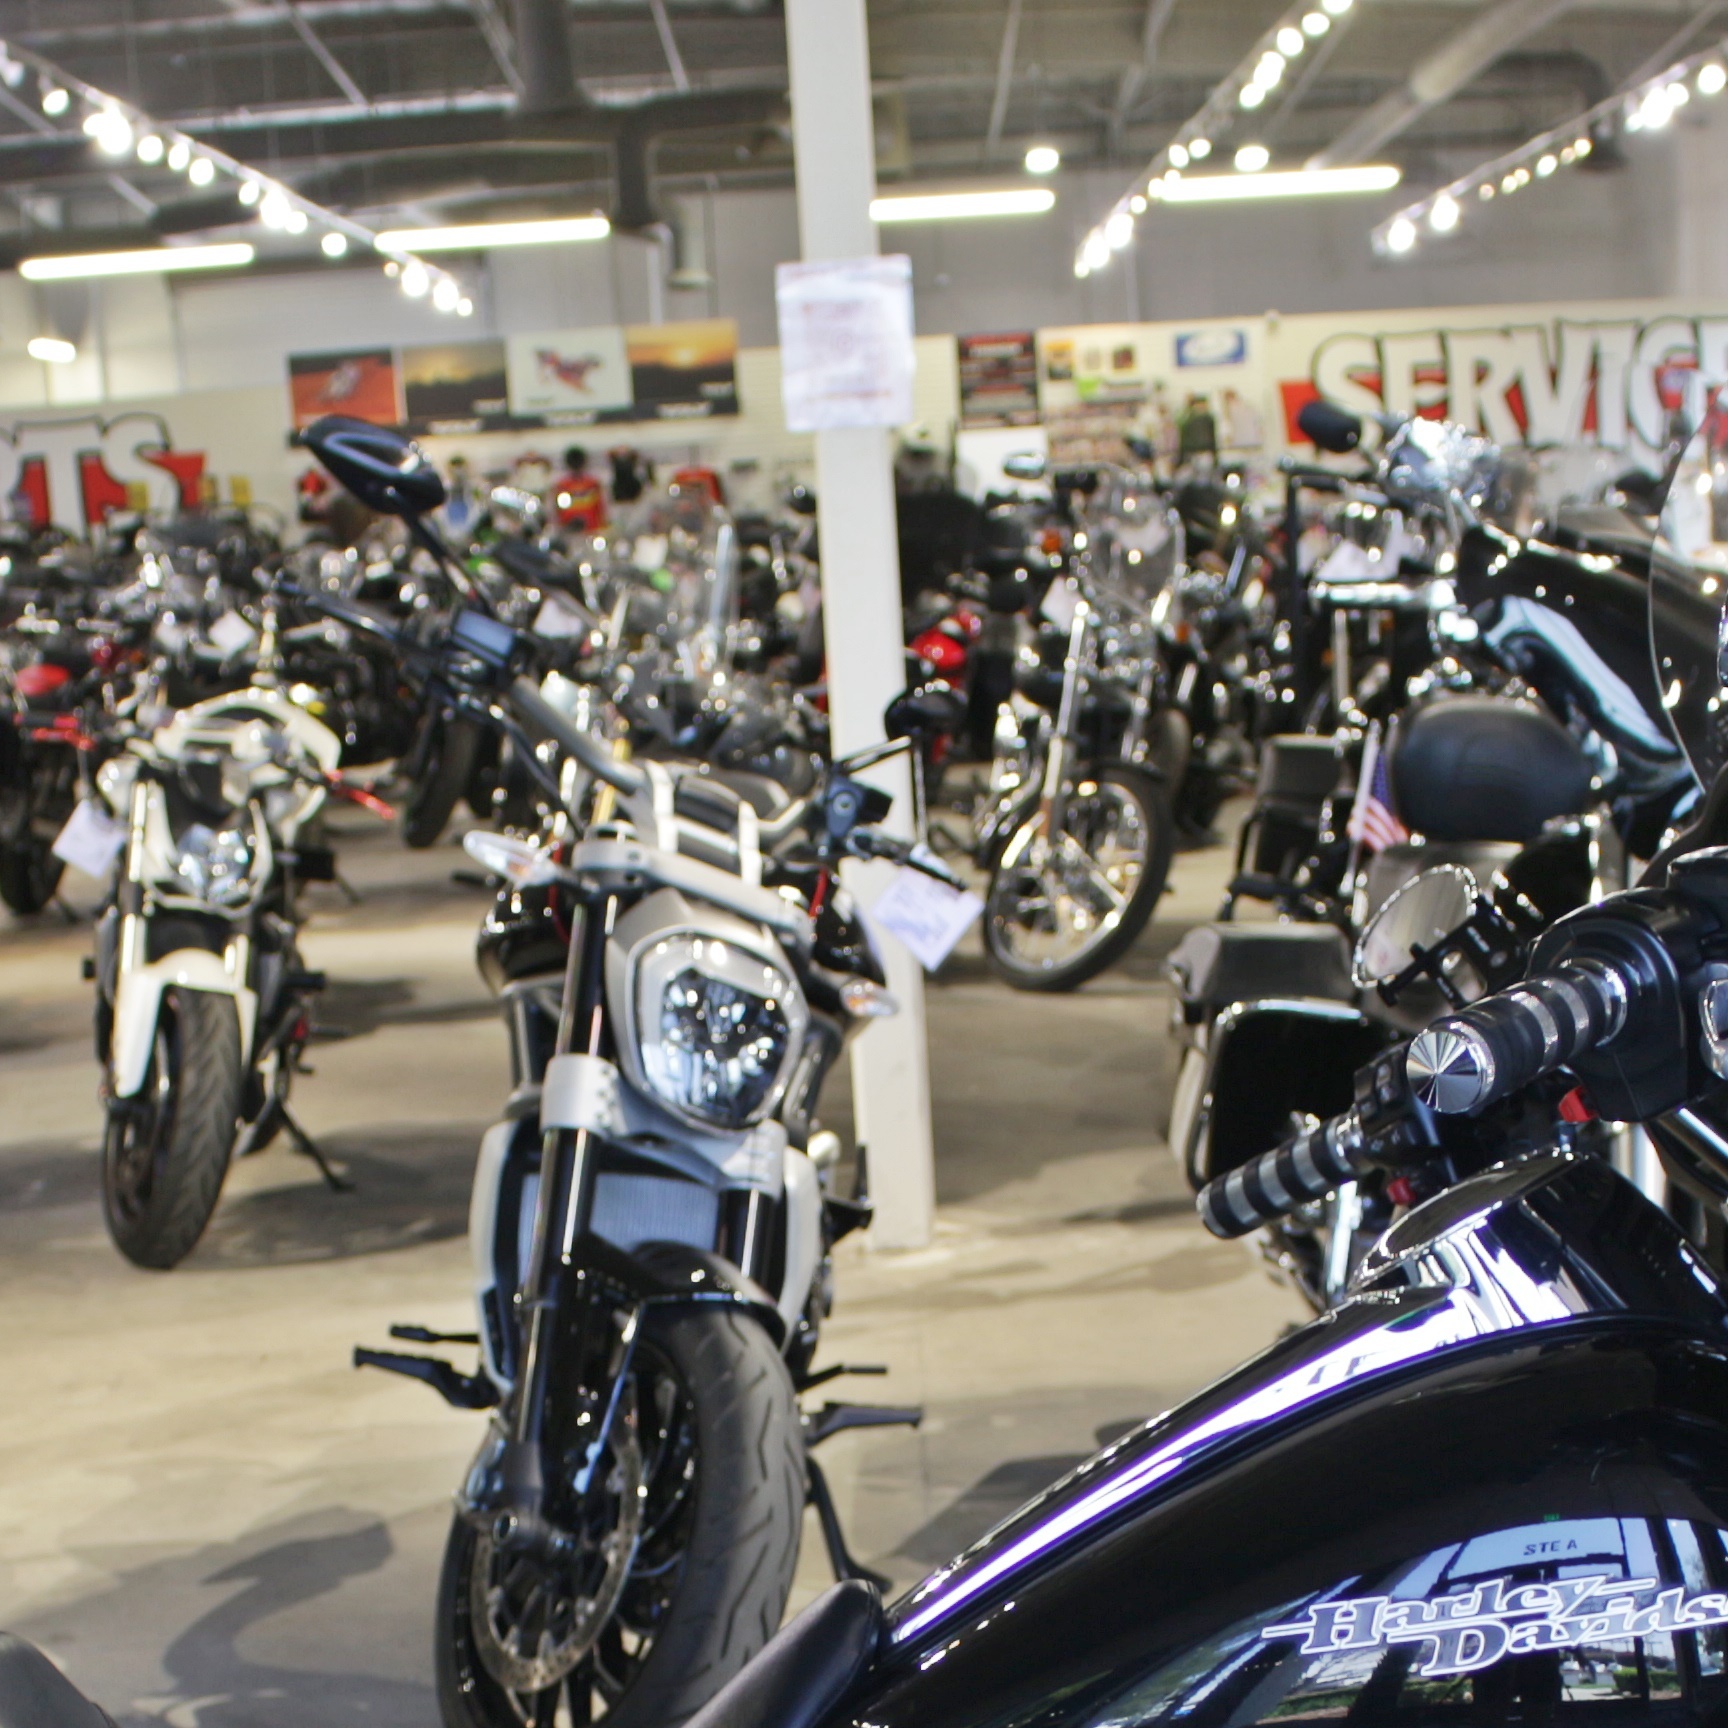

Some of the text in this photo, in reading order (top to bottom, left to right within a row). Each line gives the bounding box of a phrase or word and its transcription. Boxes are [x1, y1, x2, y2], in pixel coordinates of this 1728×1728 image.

[1523, 1539, 1578, 1556] STE A
[1277, 1574, 1637, 1655] Harley
